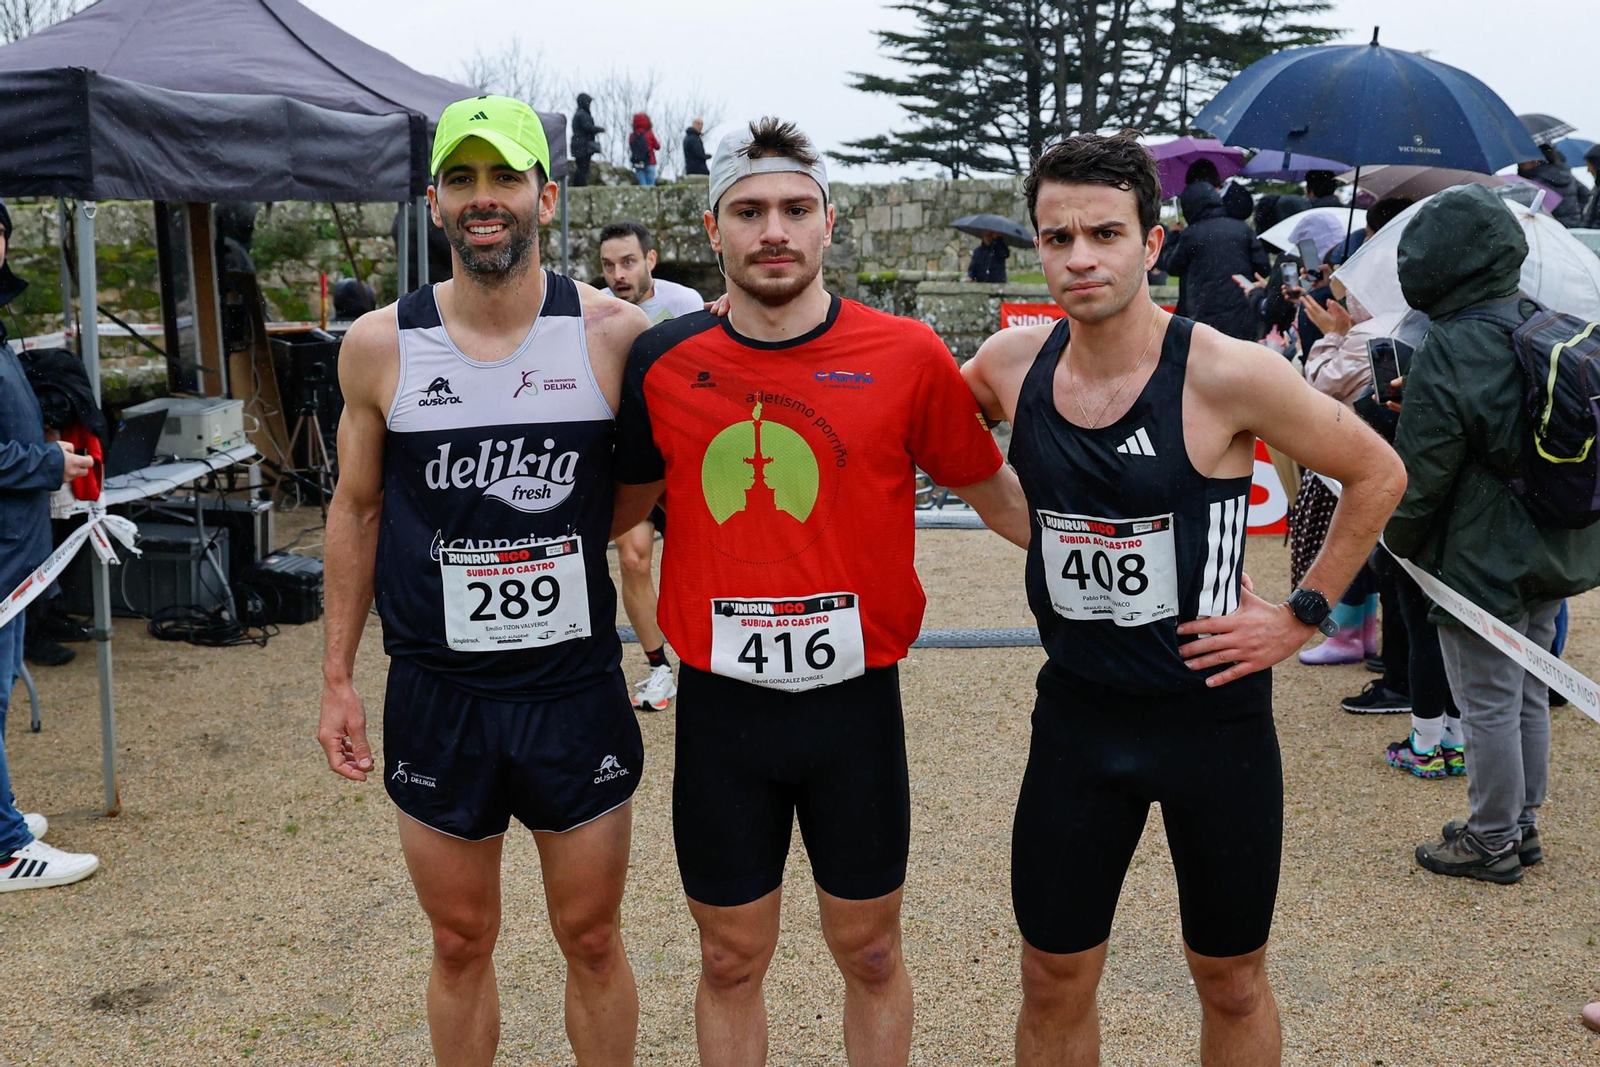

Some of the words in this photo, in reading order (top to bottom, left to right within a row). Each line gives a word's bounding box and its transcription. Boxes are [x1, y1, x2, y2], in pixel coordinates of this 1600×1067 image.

[544, 383, 578, 391] DELIKIA
[745, 390, 815, 418] atletismo
[812, 415, 848, 468] porriño
[425, 437, 580, 490] delikia
[512, 484, 552, 501] fresh
[1059, 534, 1091, 545] SUBIDA
[1093, 537, 1104, 546] AO
[1104, 539, 1143, 550] CASTRO
[466, 568, 500, 577] SUBIDA
[502, 567, 515, 575] AO
[516, 561, 555, 574] CASTRO
[1061, 549, 1149, 596] 408
[466, 575, 561, 622] 289
[520, 621, 549, 629] VALVERDE
[741, 618, 773, 628] SUBIDA
[775, 618, 789, 627] AO
[790, 615, 829, 627] CASTRO
[737, 628, 836, 674] 416
[801, 674, 824, 683] BORGES
[410, 776, 437, 788] DELIKIA
